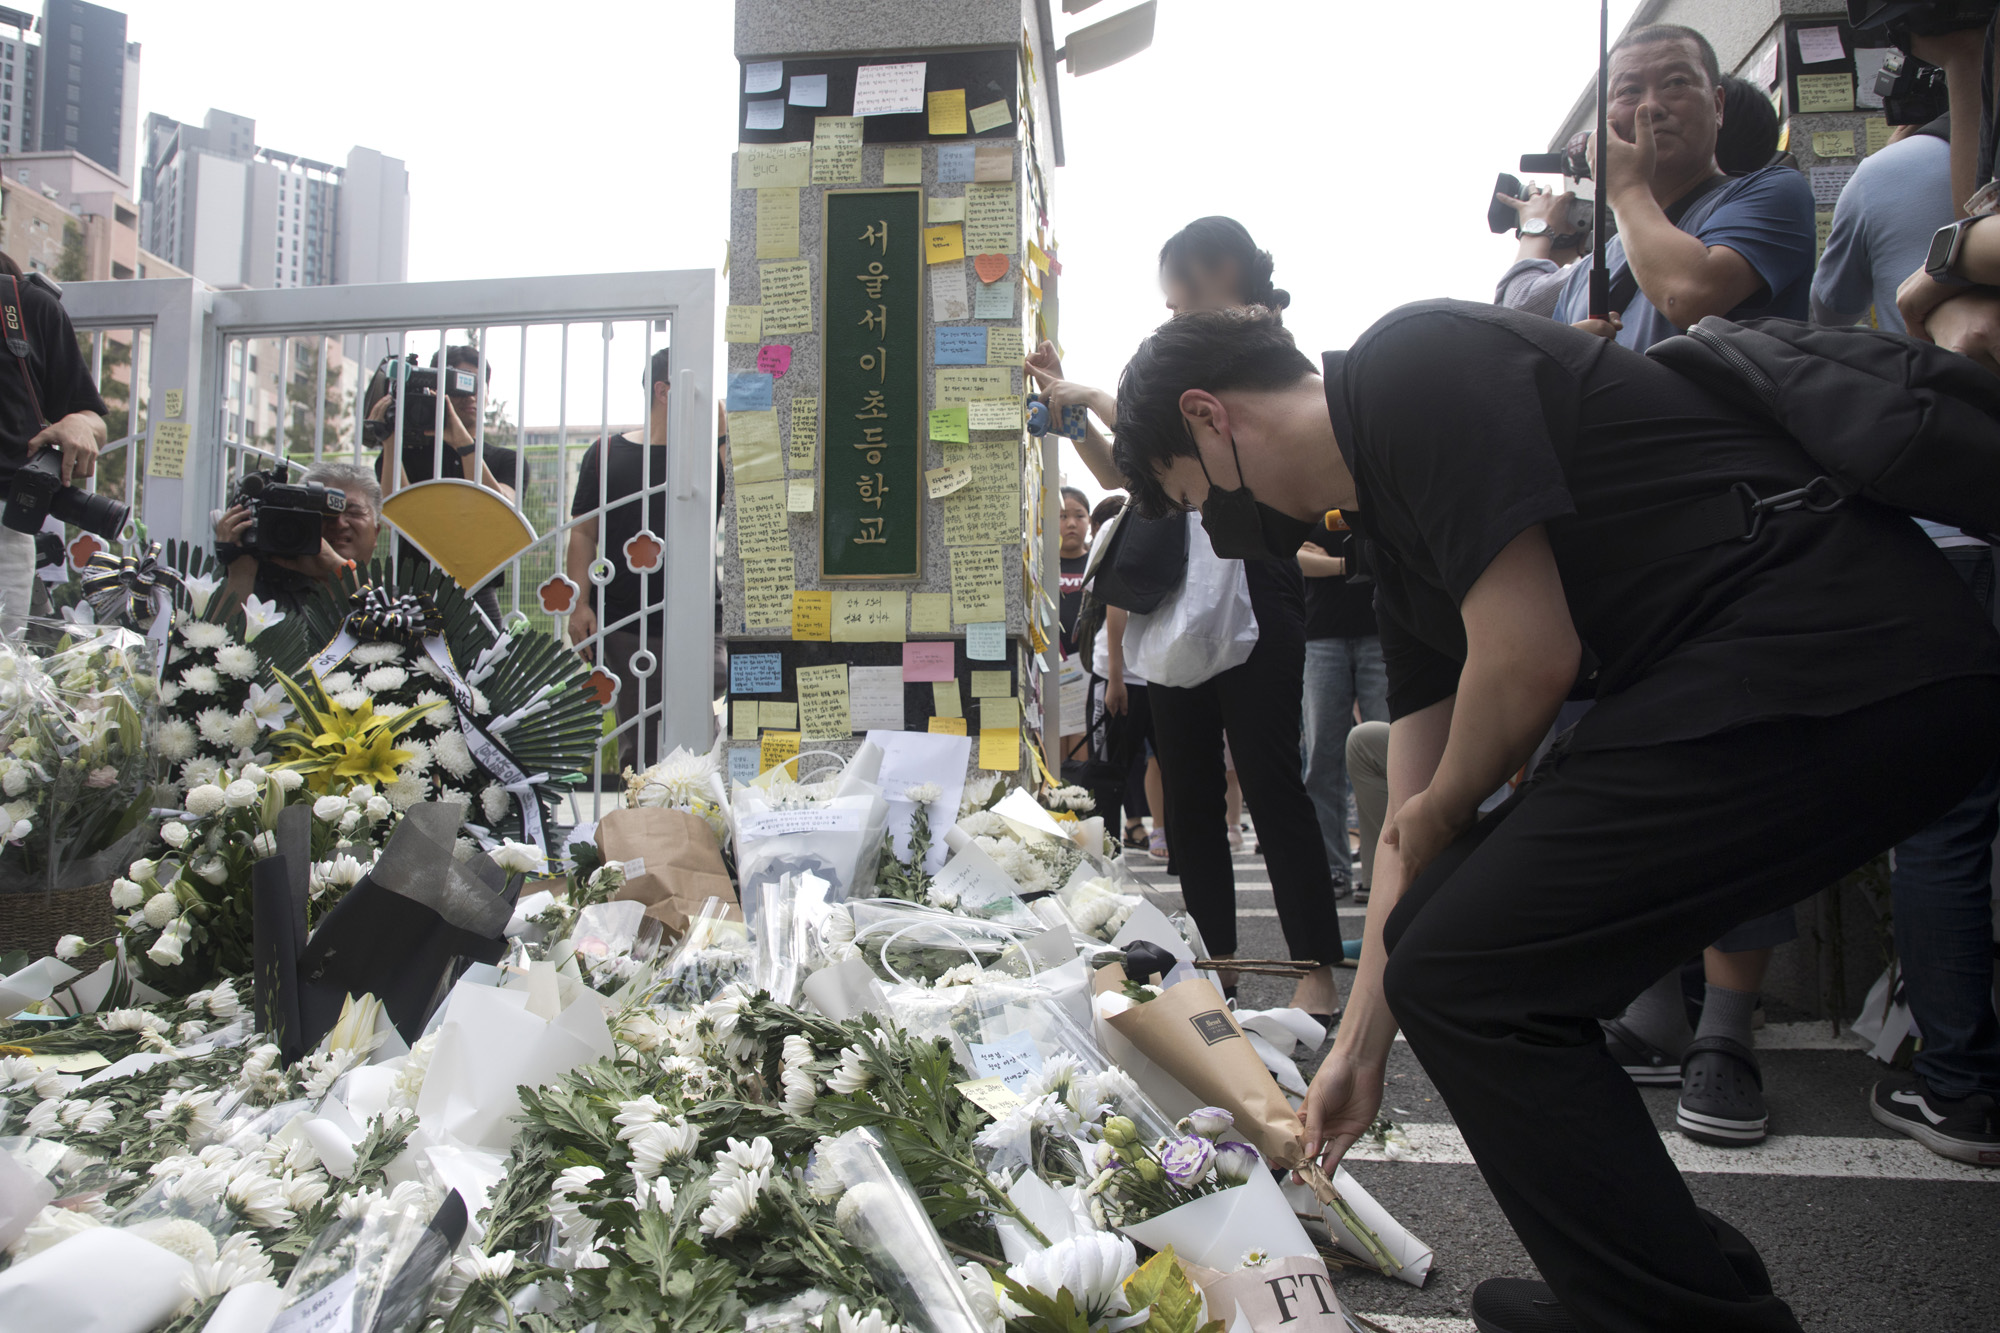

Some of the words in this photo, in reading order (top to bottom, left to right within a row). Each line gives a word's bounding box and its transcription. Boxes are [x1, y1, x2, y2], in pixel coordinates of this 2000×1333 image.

[753, 165, 778, 177] 빕니다
[7, 304, 19, 330] EOS
[854, 219, 889, 545] 서울서이초등학교
[328, 495, 346, 510] SBS
[1058, 577, 1084, 587] evi
[1264, 1273, 1335, 1325] FT
